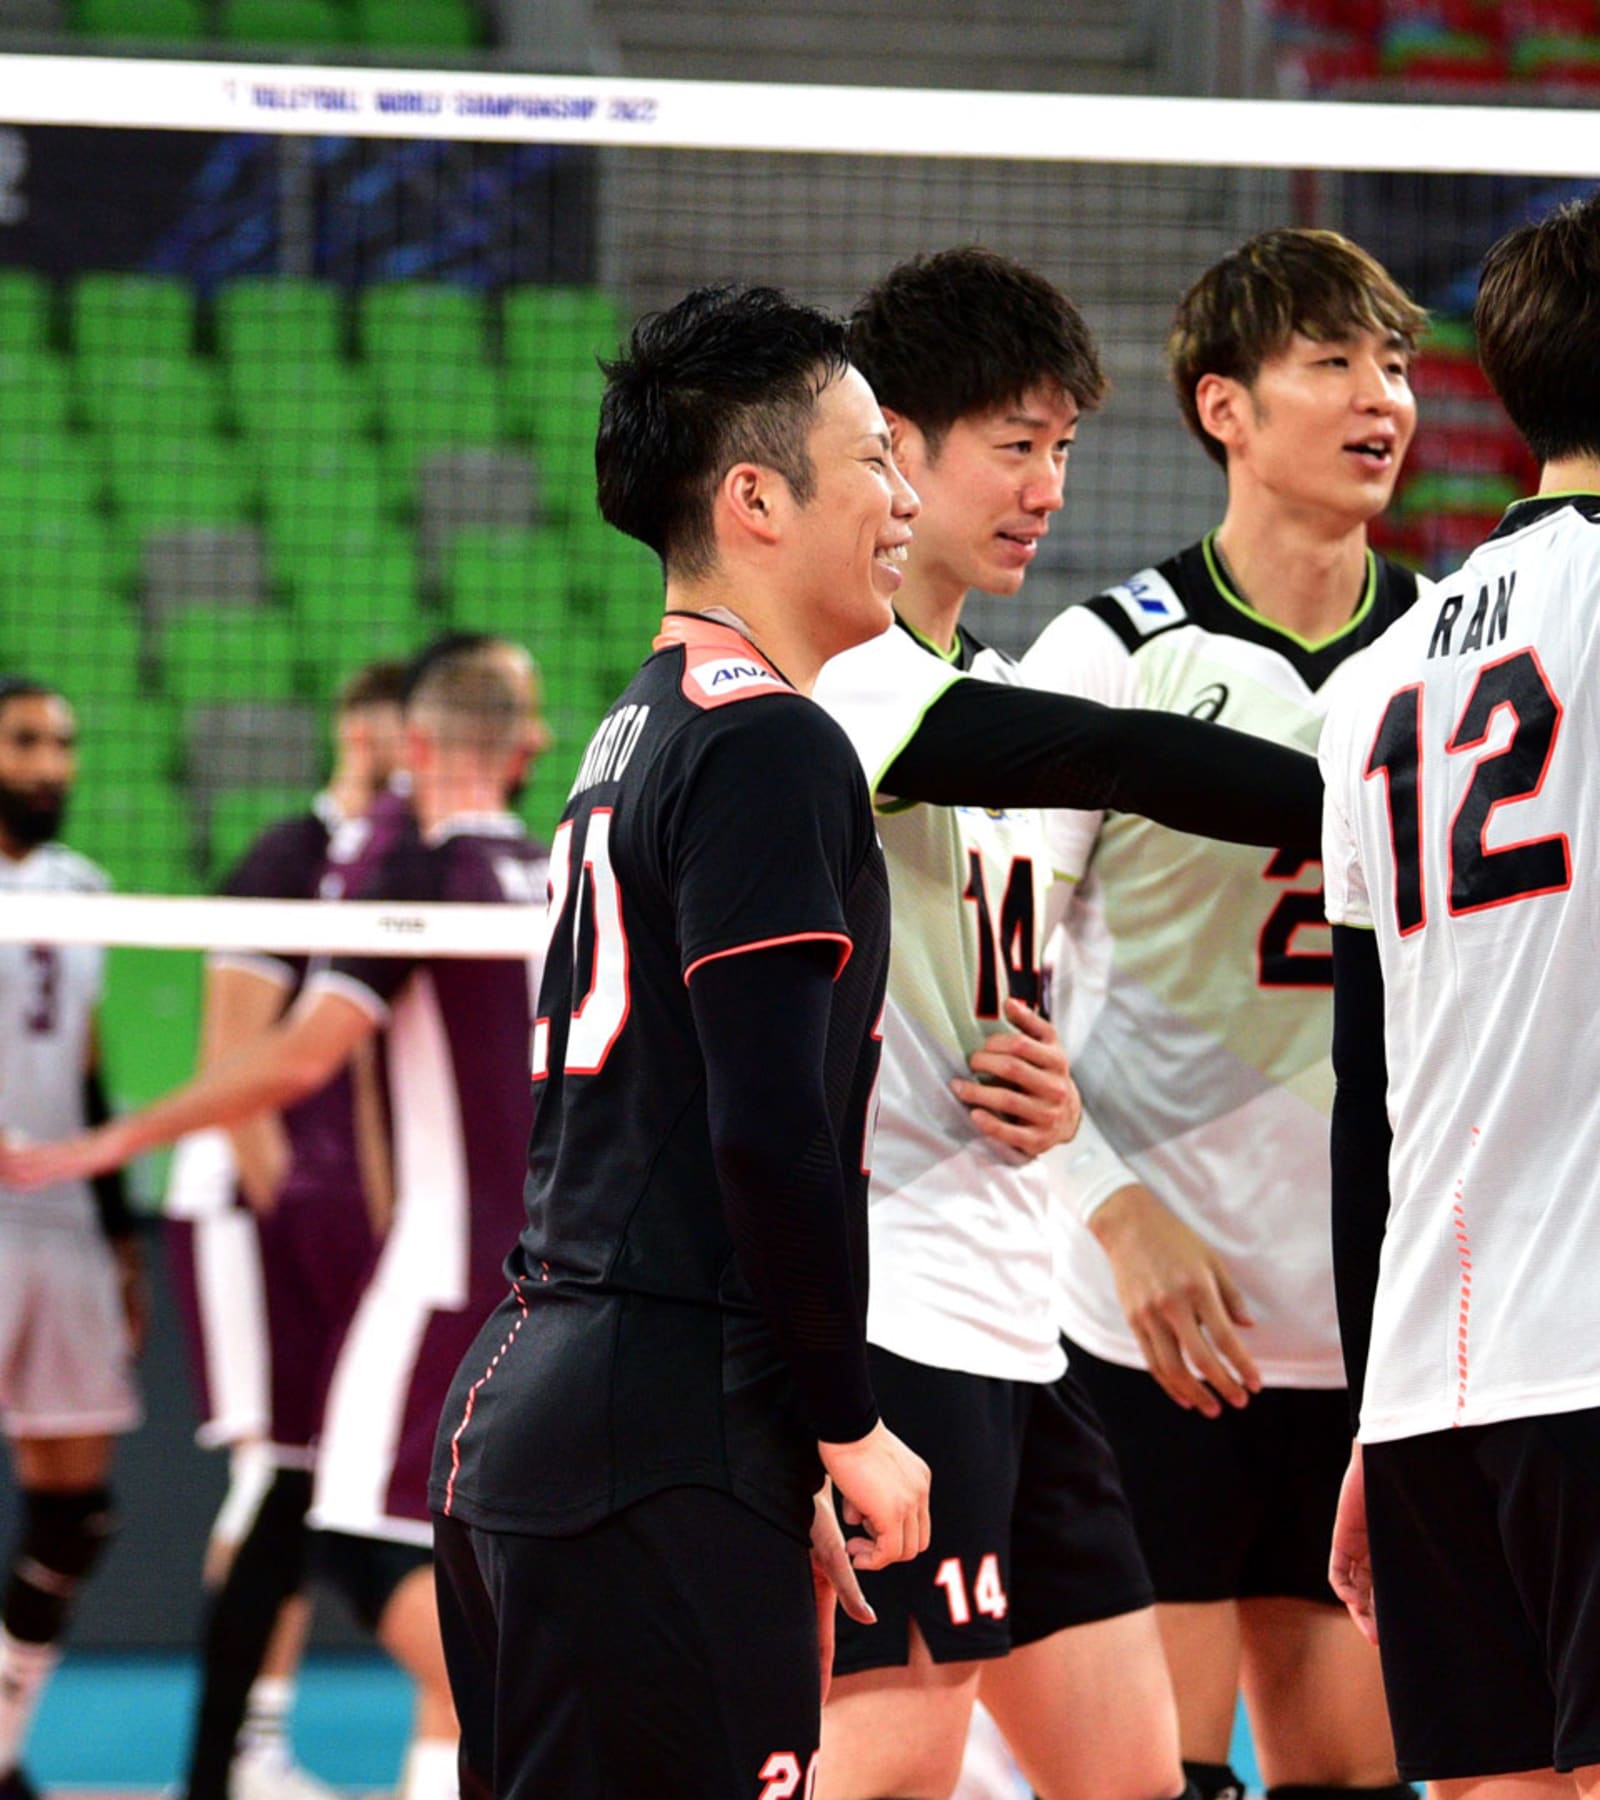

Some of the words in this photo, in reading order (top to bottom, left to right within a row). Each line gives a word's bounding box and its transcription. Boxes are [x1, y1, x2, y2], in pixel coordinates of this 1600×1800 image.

[1427, 571, 1517, 660] RAN
[1364, 646, 1573, 938] 12
[963, 848, 1057, 1022] 14
[934, 1553, 1008, 1625] 14
